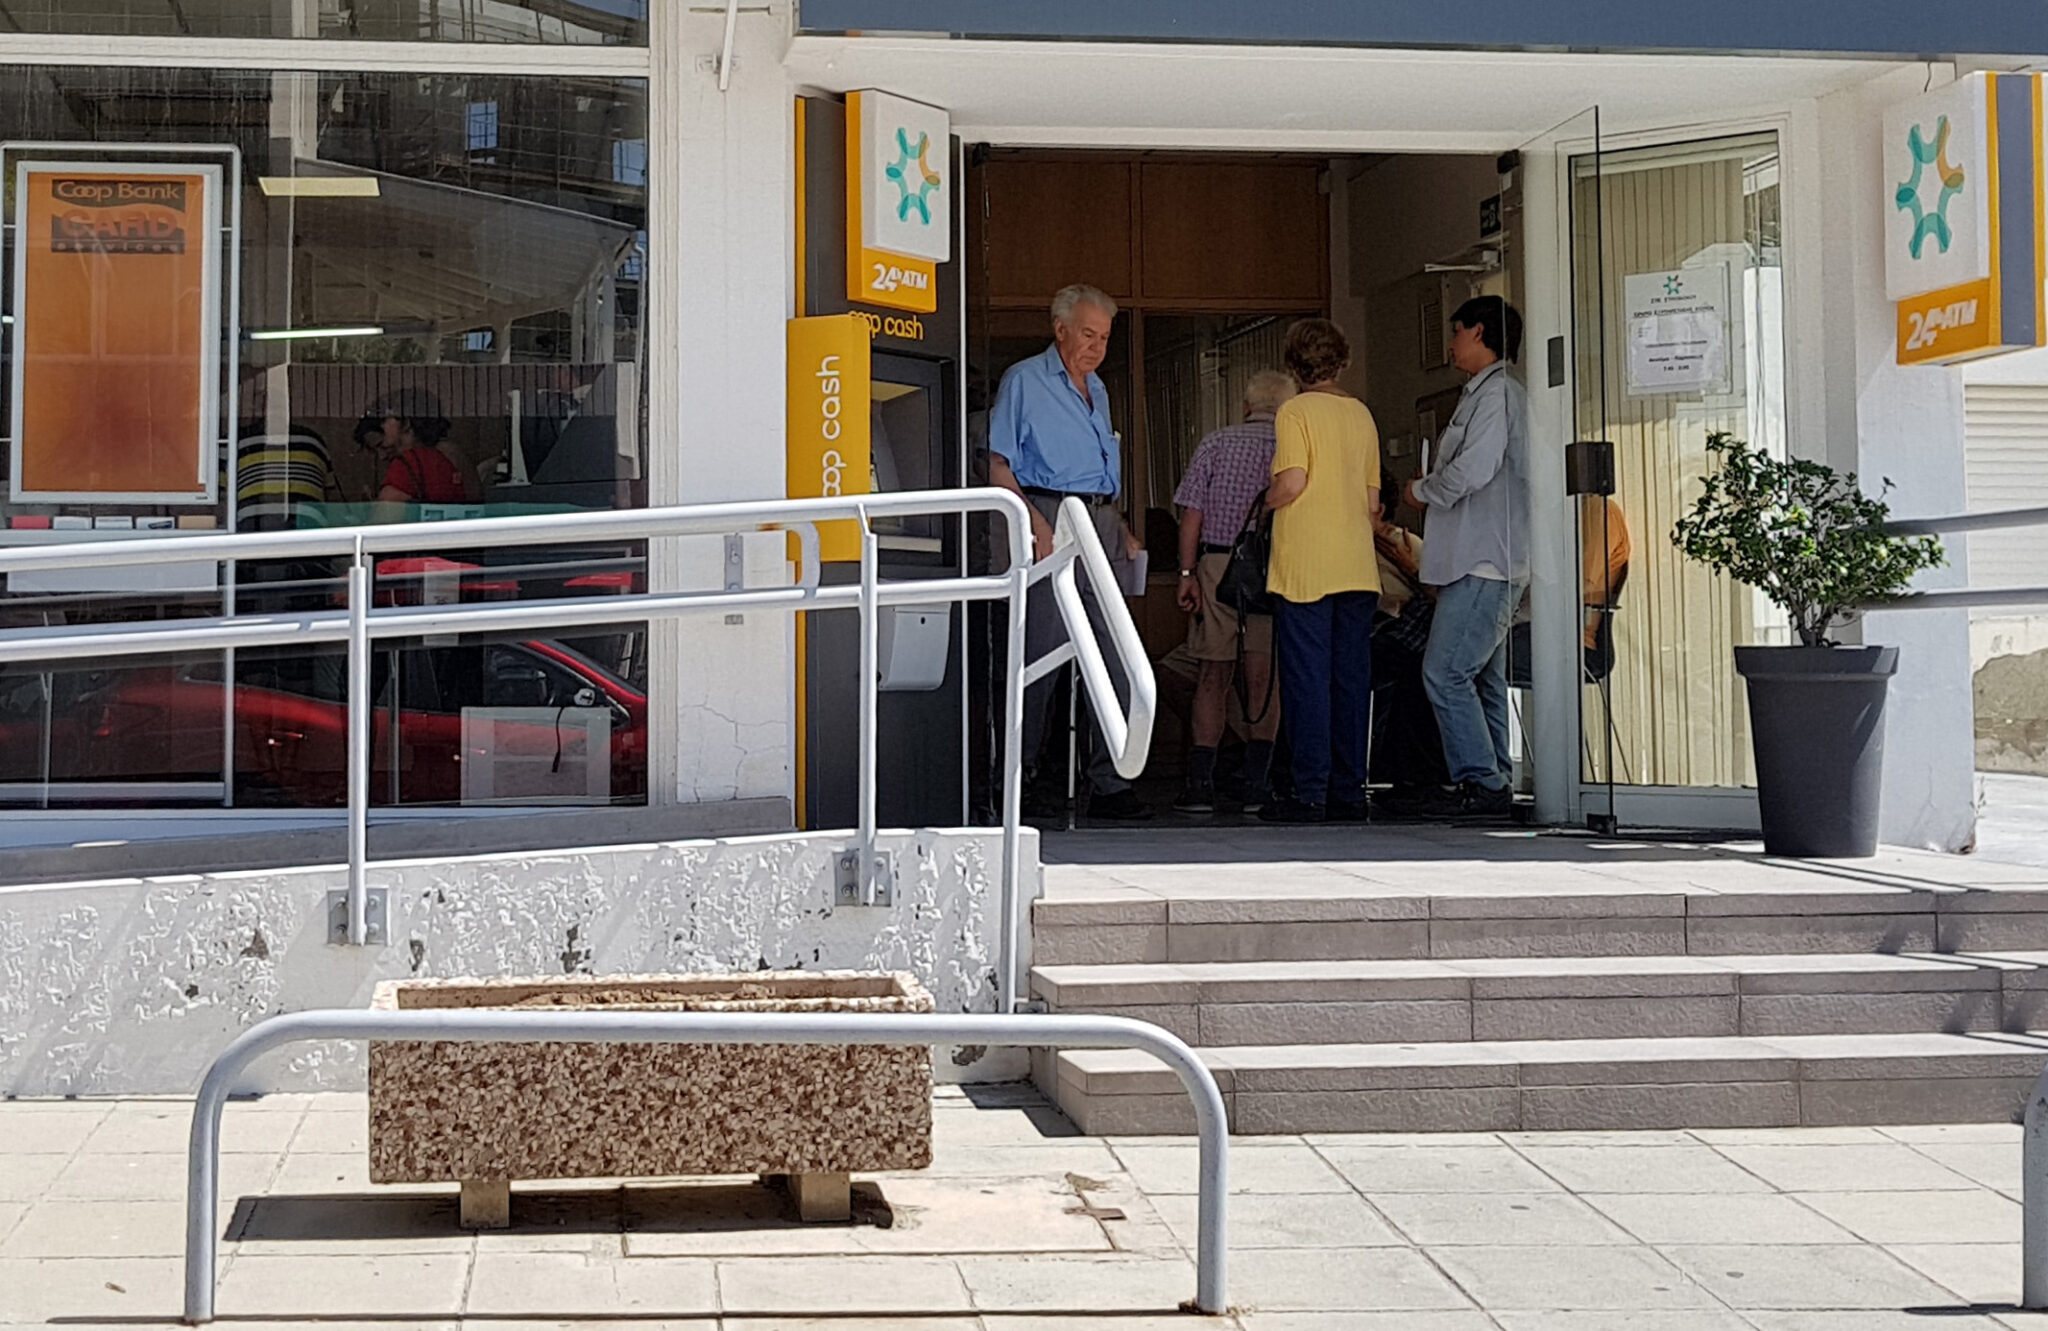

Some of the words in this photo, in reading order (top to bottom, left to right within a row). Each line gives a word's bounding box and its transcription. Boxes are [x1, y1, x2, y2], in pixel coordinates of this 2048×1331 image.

[57, 181, 113, 202] Coop
[118, 182, 179, 199] Bank
[61, 209, 178, 238] CARD
[901, 270, 928, 289] ATM
[884, 315, 923, 340] cash
[1941, 299, 1978, 330] ATM
[816, 355, 841, 440] cash
